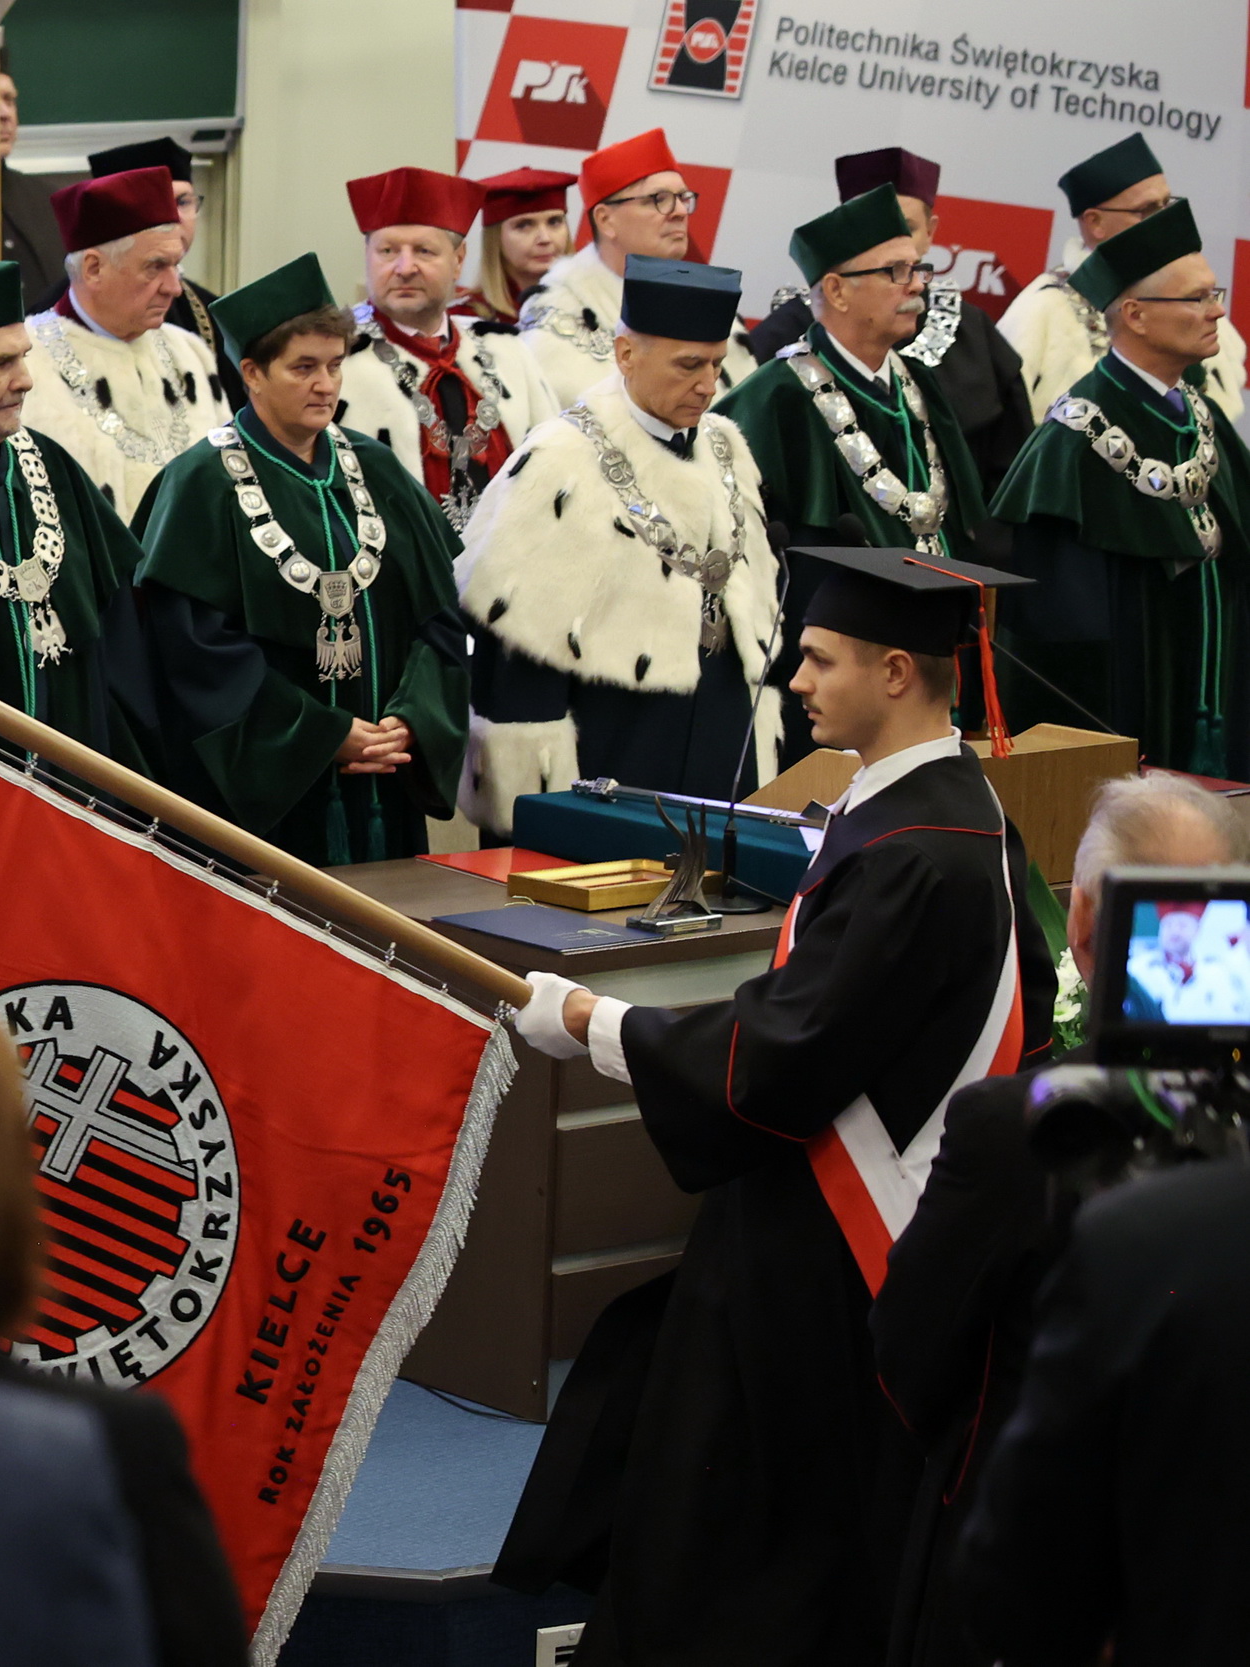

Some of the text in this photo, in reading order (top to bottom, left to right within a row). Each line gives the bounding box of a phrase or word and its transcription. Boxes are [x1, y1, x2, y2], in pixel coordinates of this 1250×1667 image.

[768, 50, 1222, 141] Kielce University of Technology
[775, 16, 1161, 91] Politechnika Świętokrzyska
[235, 1218, 326, 1405] KIELCE
[258, 1167, 412, 1504] ROK ZAŁOŻENIA 1965
